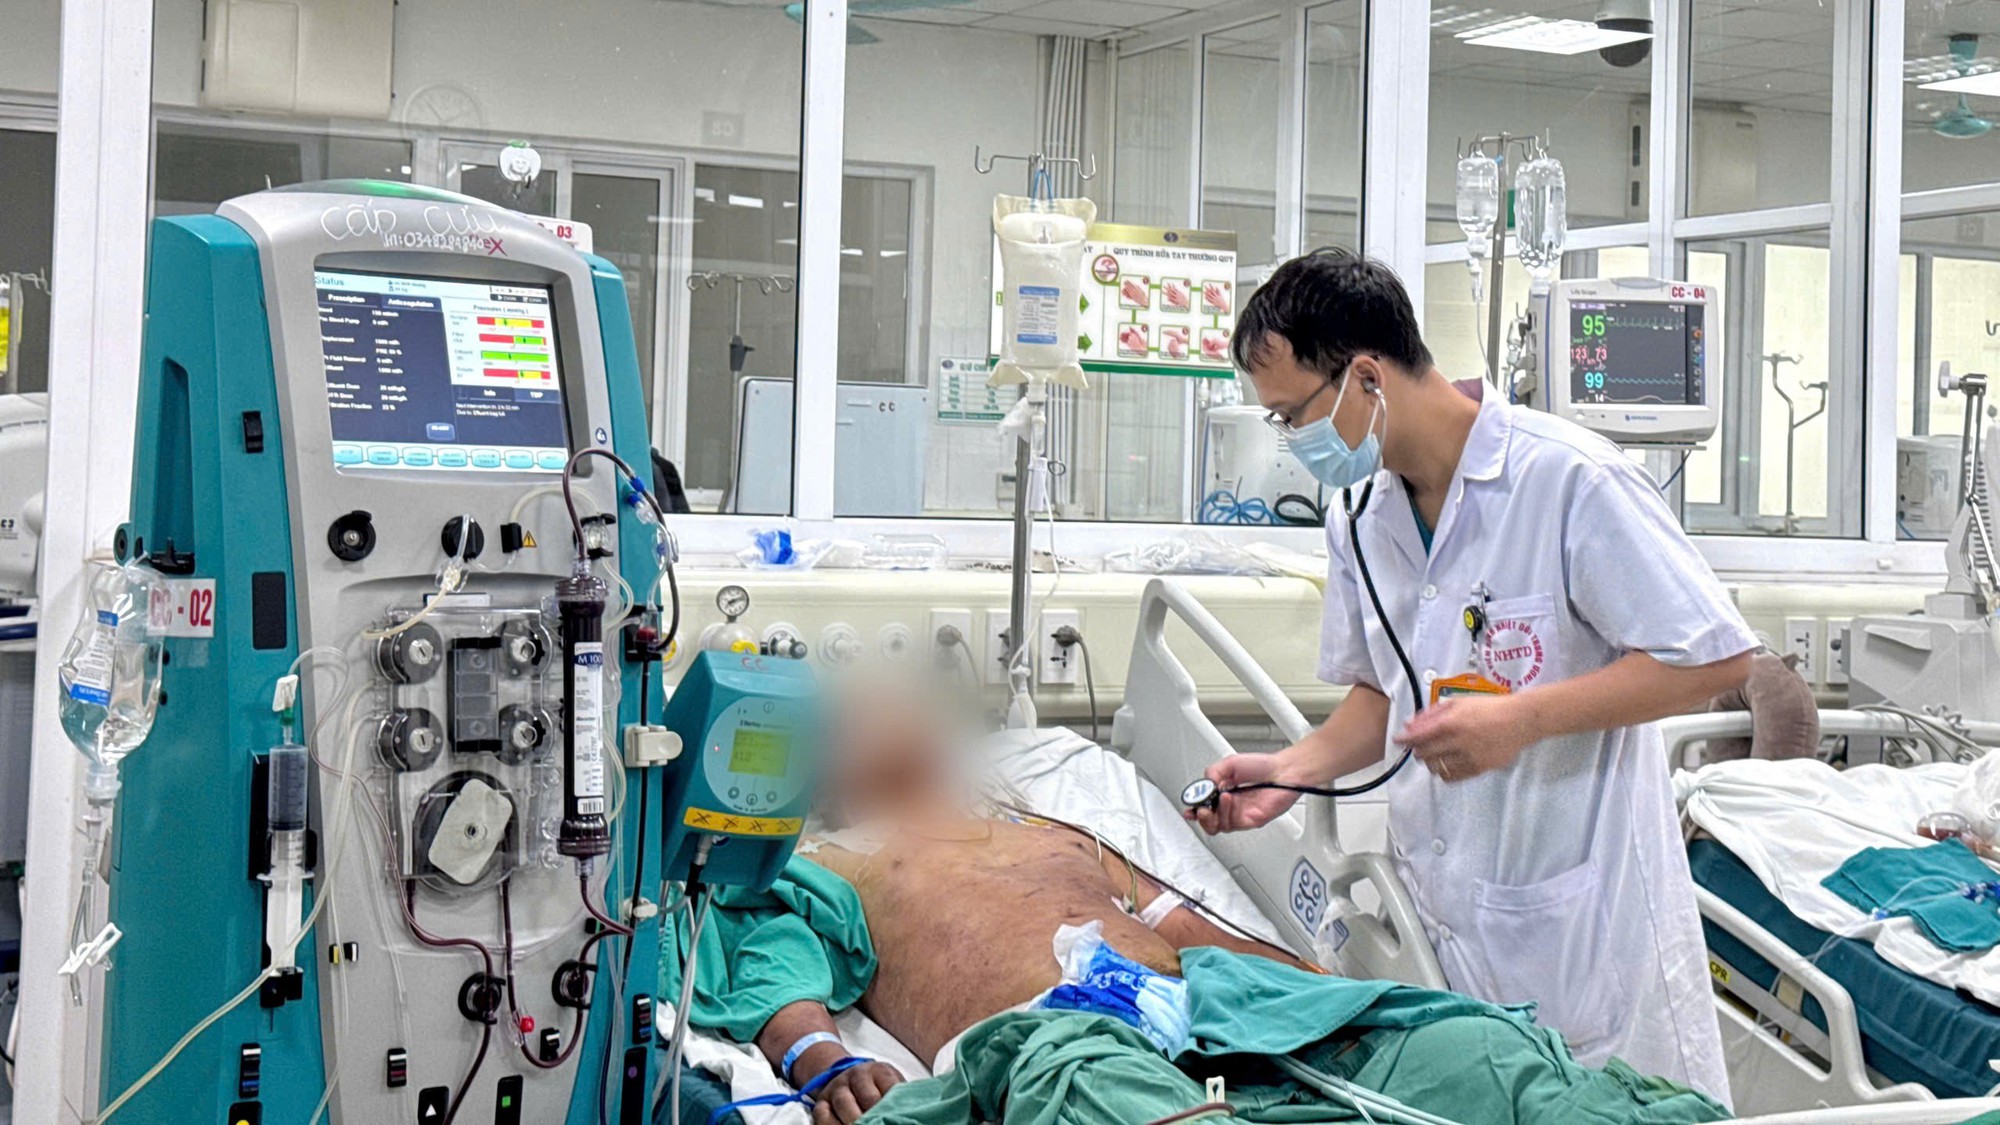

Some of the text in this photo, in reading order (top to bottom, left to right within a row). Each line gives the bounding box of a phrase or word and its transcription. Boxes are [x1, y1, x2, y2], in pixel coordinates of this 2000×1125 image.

[556, 225, 573, 239] 03
[1113, 247, 1129, 256] QUY
[1131, 247, 1154, 257] TRÌNH
[1172, 252, 1186, 260] TAY
[1218, 255, 1234, 263] QUY
[314, 275, 345, 286] Status
[1671, 286, 1686, 298] CC
[1693, 287, 1706, 299] 04
[1582, 315, 1605, 336] 95
[1571, 347, 1607, 361] 123 73
[1585, 373, 1604, 388] 99
[190, 588, 213, 627] 02
[578, 655, 588, 664] M
[1494, 646, 1532, 662] NHTD
[1710, 961, 1728, 982] CPR
